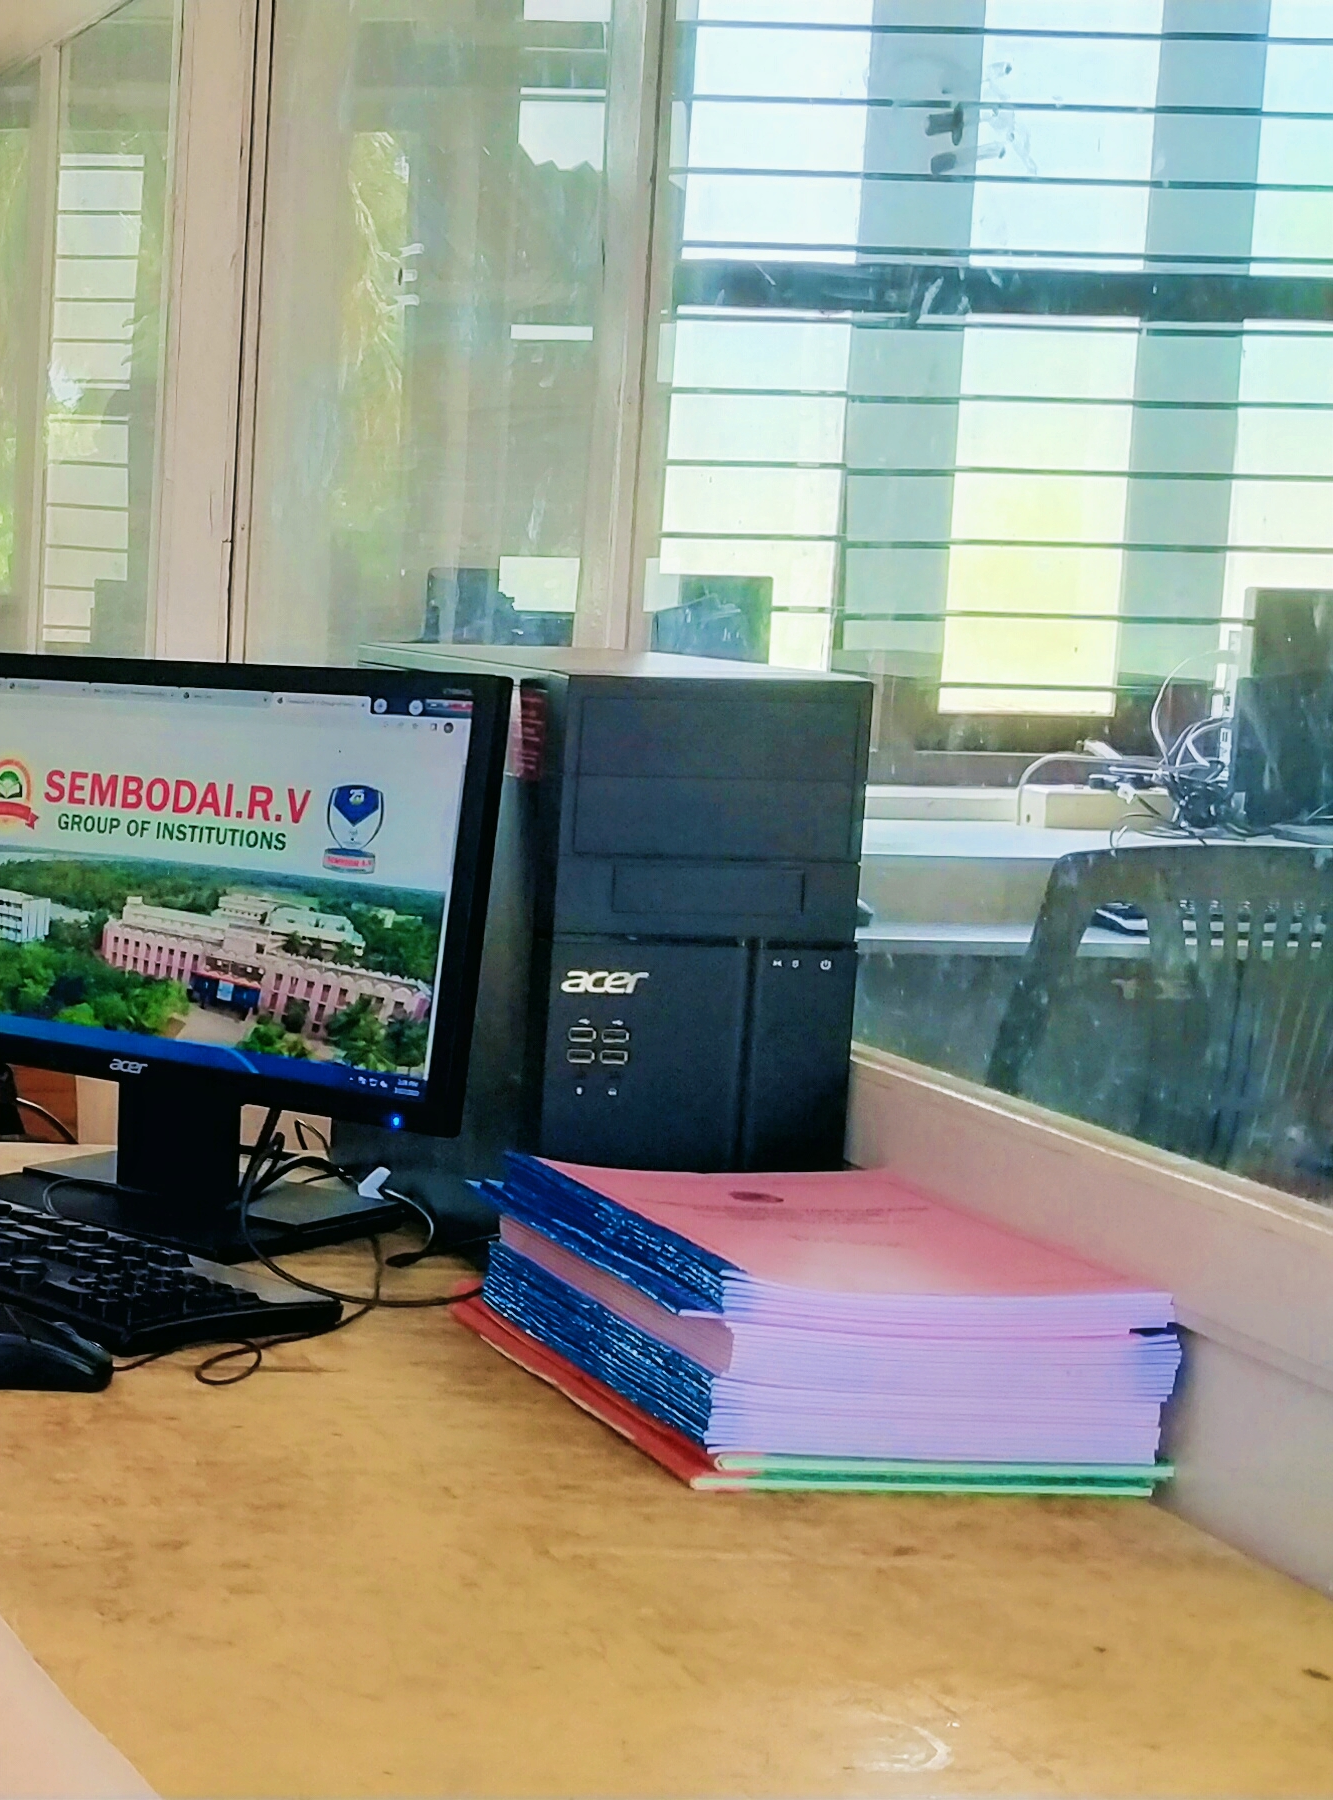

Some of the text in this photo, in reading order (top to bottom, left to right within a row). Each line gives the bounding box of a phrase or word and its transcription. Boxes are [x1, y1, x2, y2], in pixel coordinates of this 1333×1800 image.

[44, 769, 312, 825] SEMBODAI.R.V
[57, 813, 287, 851] GROUP OF INSTITUTIONS
[560, 970, 650, 994] acer
[109, 1058, 148, 1074] acer
